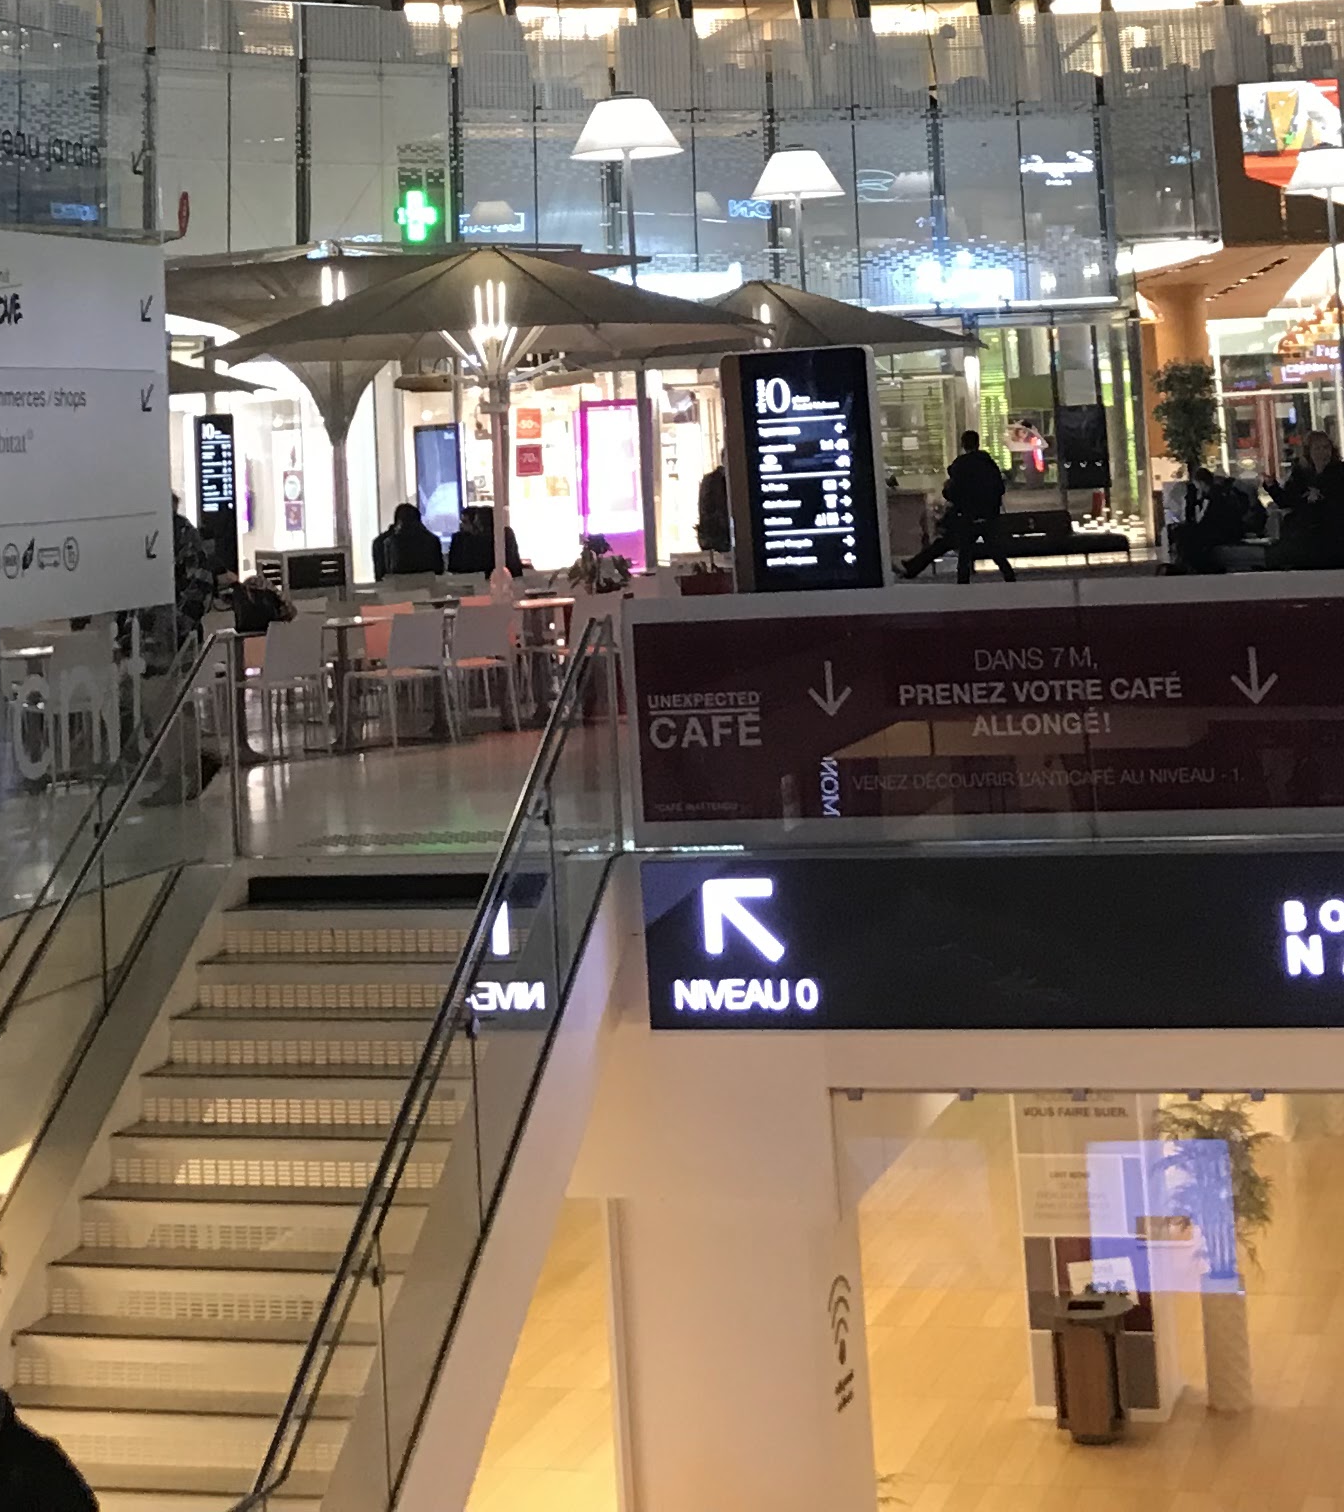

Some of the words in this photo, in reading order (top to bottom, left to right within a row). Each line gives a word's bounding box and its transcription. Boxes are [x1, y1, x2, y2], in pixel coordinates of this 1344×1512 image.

[53, 387, 87, 412] shops
[974, 649, 1044, 672] DANS
[647, 691, 760, 709] UNEXPECTED
[899, 681, 1007, 706] PRENEZ
[1012, 679, 1103, 703] VOTRE
[1110, 670, 1182, 699] CAFÉ
[649, 712, 763, 749] CAFÉ
[851, 774, 907, 790] VENEZ
[1120, 769, 1144, 784] AU
[1149, 767, 1215, 784] NIVEAU
[674, 978, 790, 1011] NIVEAU
